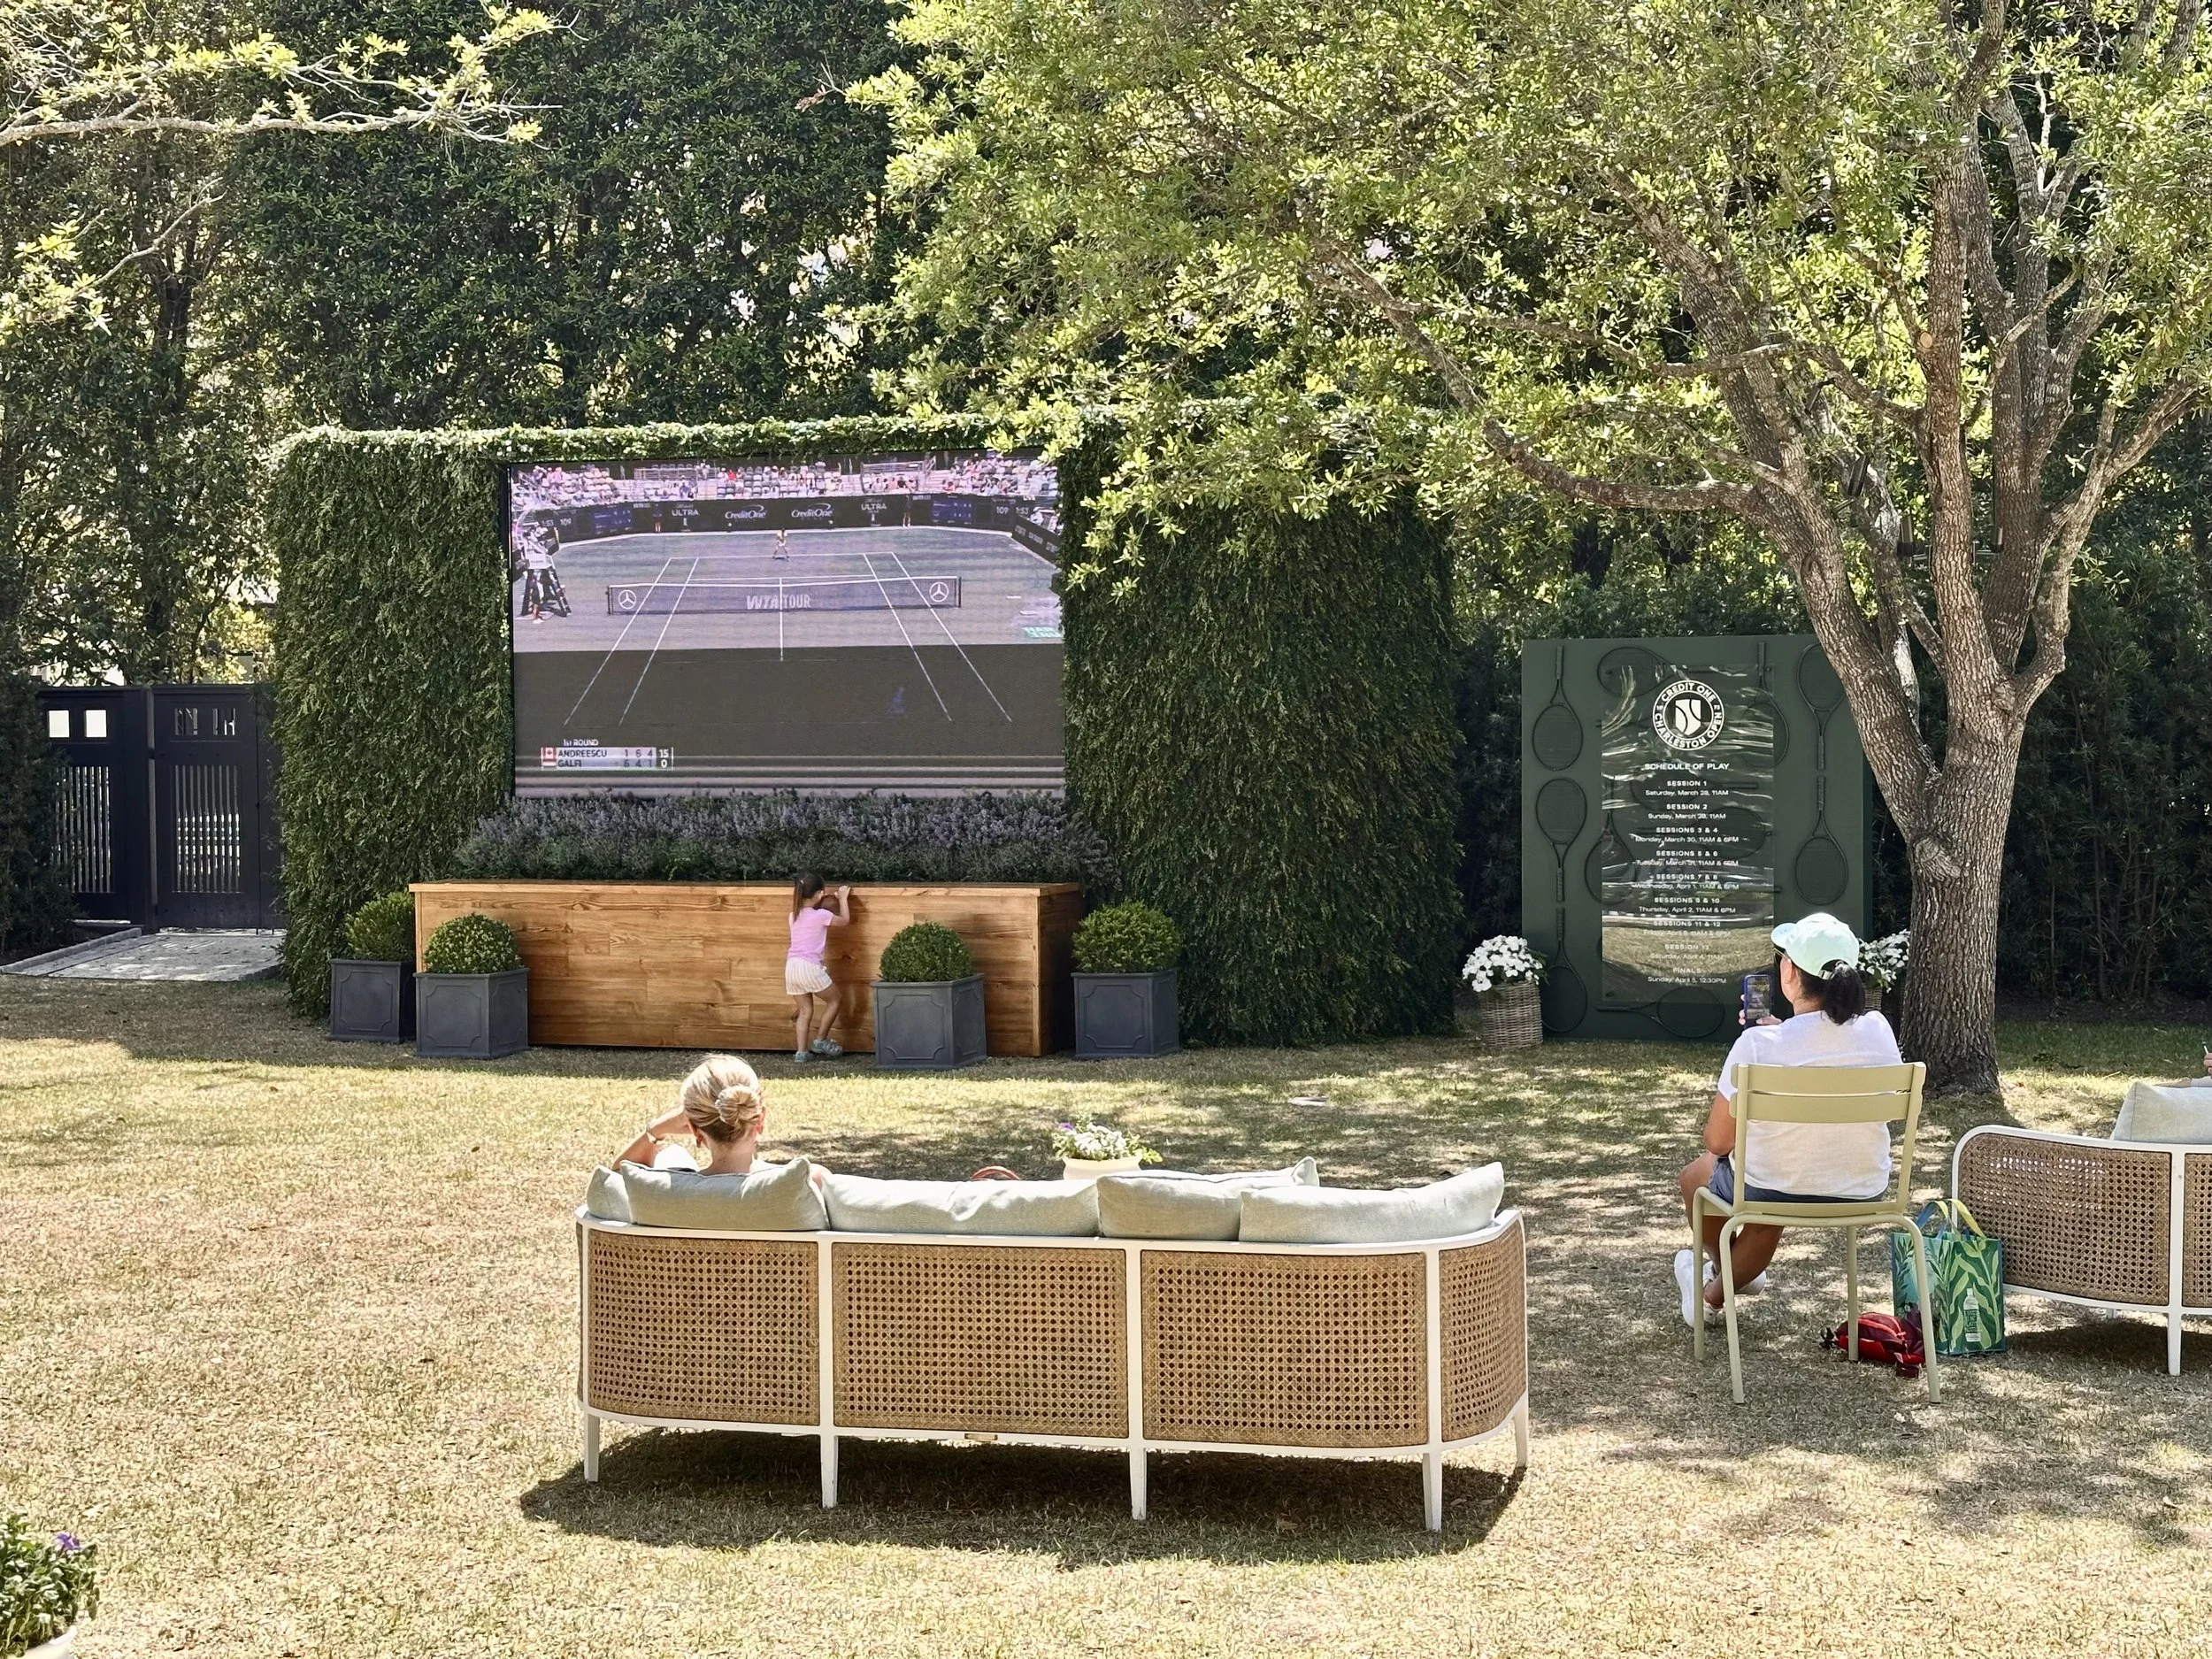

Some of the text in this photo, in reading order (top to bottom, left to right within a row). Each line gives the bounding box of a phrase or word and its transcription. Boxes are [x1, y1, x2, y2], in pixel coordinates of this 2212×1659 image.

[747, 595, 811, 610] WTA TOUR
[1662, 683, 1717, 703] CREDIT ONE
[1655, 712, 1722, 749] CHARLESTON OPEN
[659, 749, 669, 758] 15
[661, 759, 667, 768] 0
